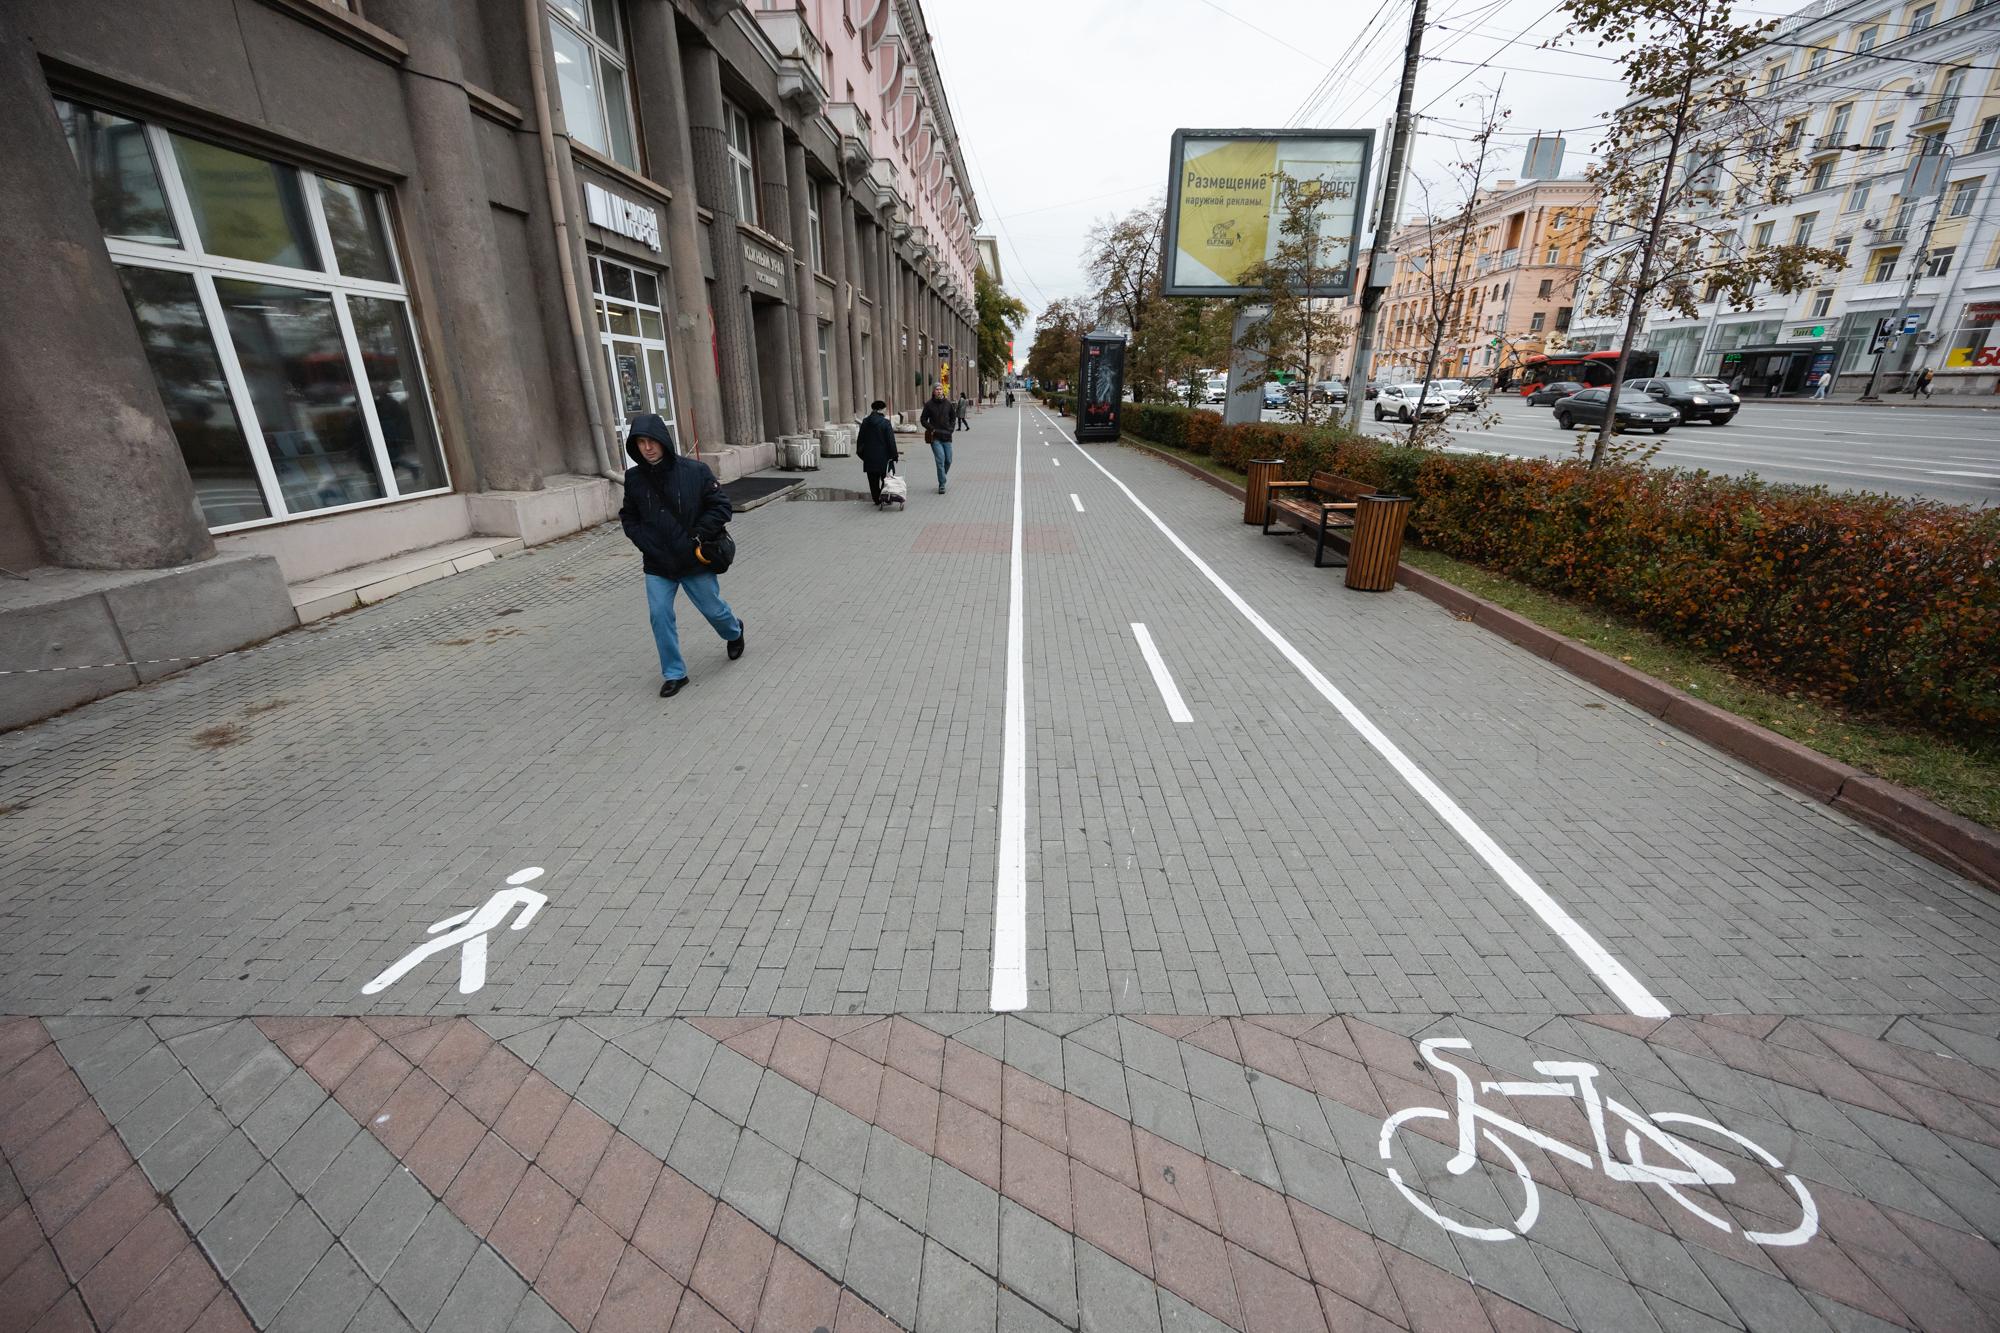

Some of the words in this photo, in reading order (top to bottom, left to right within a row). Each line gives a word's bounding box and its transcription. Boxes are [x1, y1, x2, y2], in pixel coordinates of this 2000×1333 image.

[1187, 172, 1267, 191] Размещение
[623, 199, 657, 231] ЧИТАЙ
[1185, 195, 1224, 207] наружной
[624, 220, 661, 253] ГОРОД
[743, 244, 770, 270] ЮЖНЫЙ
[770, 258, 785, 277] УРАЛ
